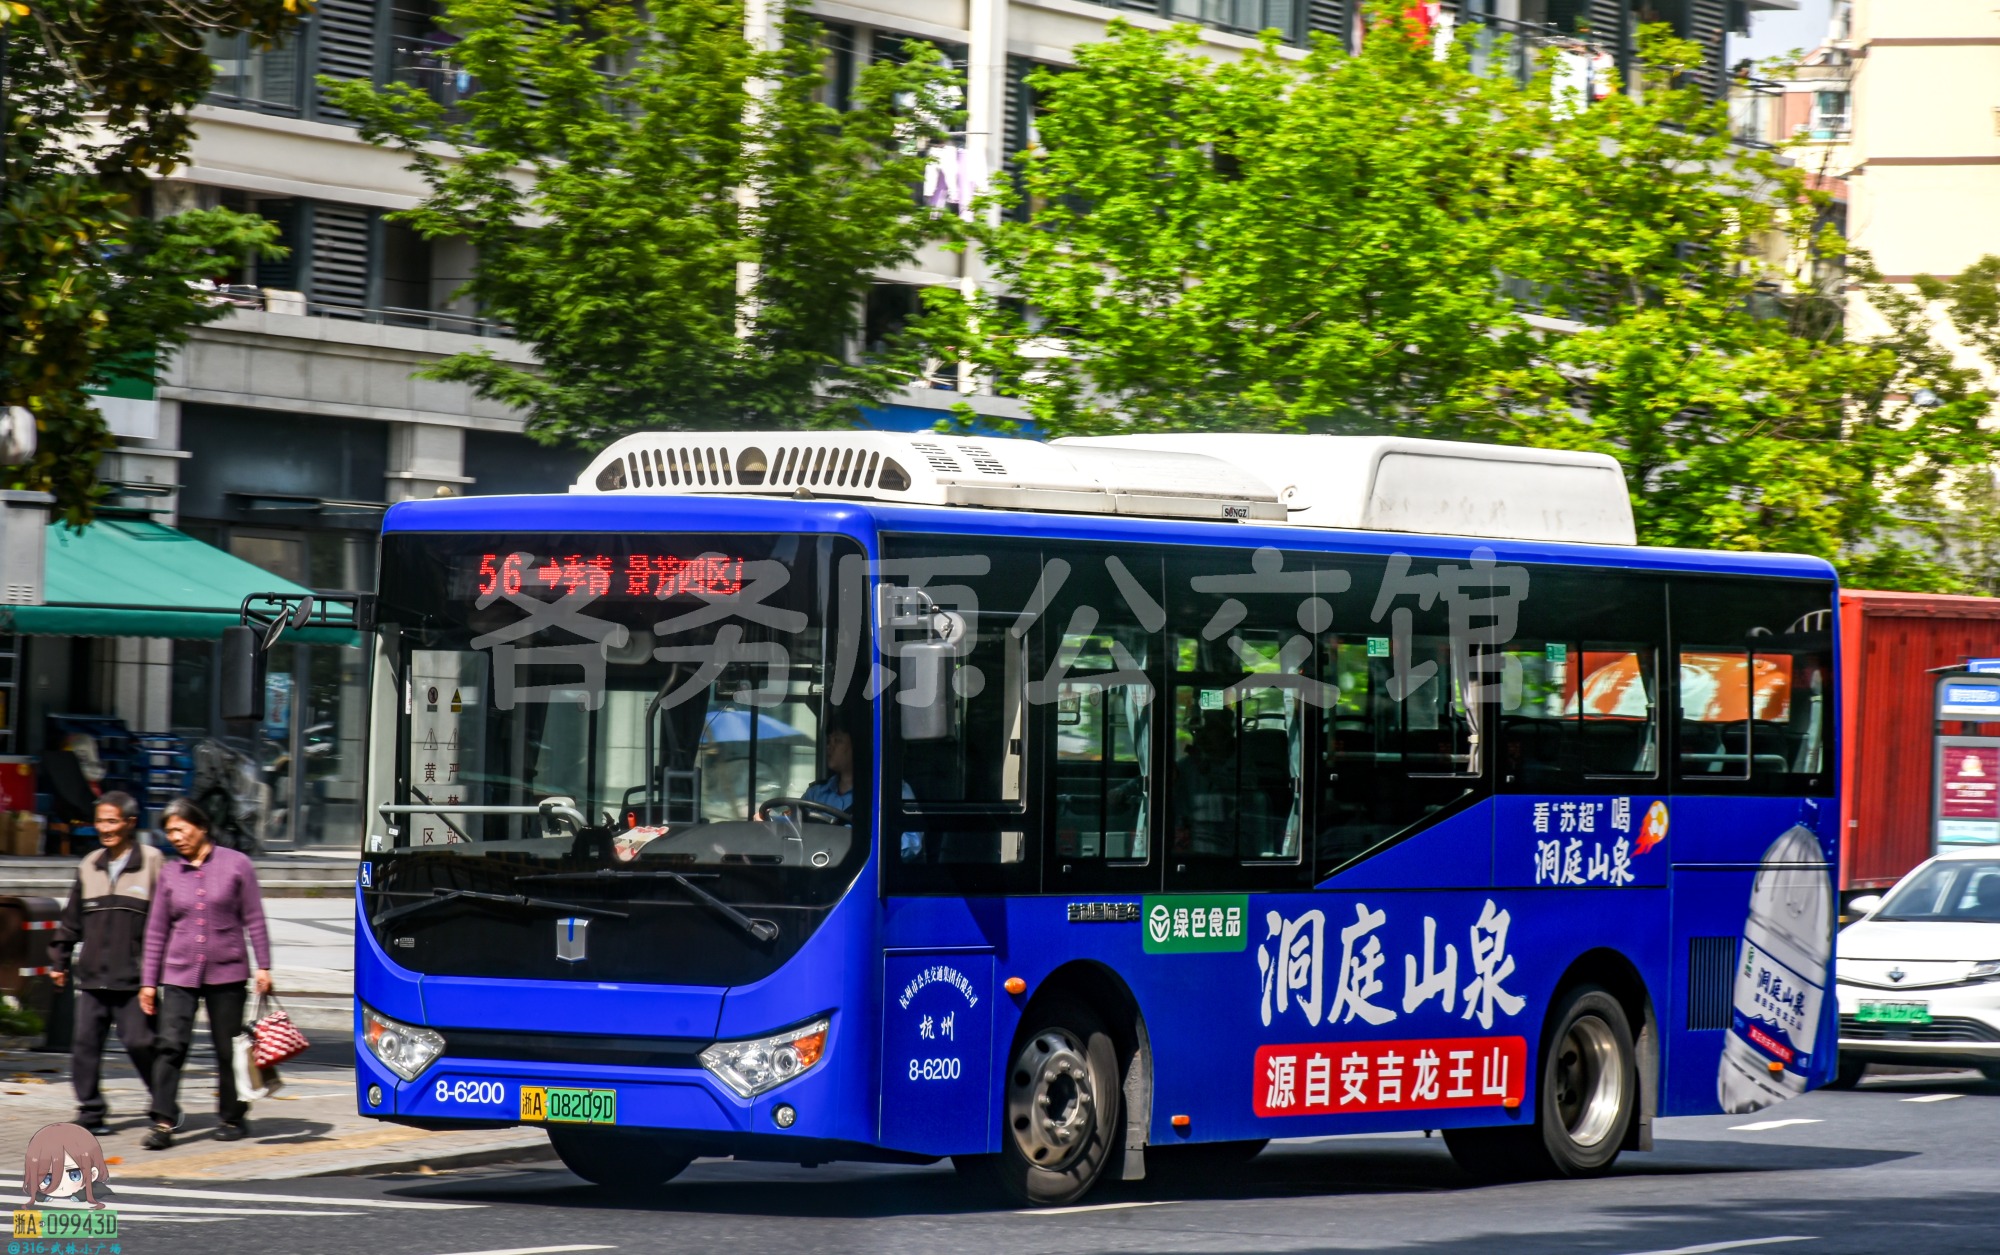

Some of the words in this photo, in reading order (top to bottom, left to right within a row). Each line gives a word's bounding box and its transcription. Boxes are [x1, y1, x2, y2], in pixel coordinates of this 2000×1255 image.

[1224, 507, 1247, 518] SONGZ
[479, 554, 522, 595] 56
[1534, 836, 1635, 887] 洞庭山泉
[1173, 906, 1241, 938] 绿色食品
[1257, 898, 1527, 1030] 洞庭山泉
[899, 965, 979, 1010] 杭州市公共交通集团有限公司
[1755, 967, 1806, 1017] 洞庭山泉
[919, 1010, 955, 1042] 杭州
[908, 1057, 961, 1081] 8-6200
[1265, 1046, 1510, 1109] 源自安吉龙王山
[435, 1080, 505, 1104] 8-6200
